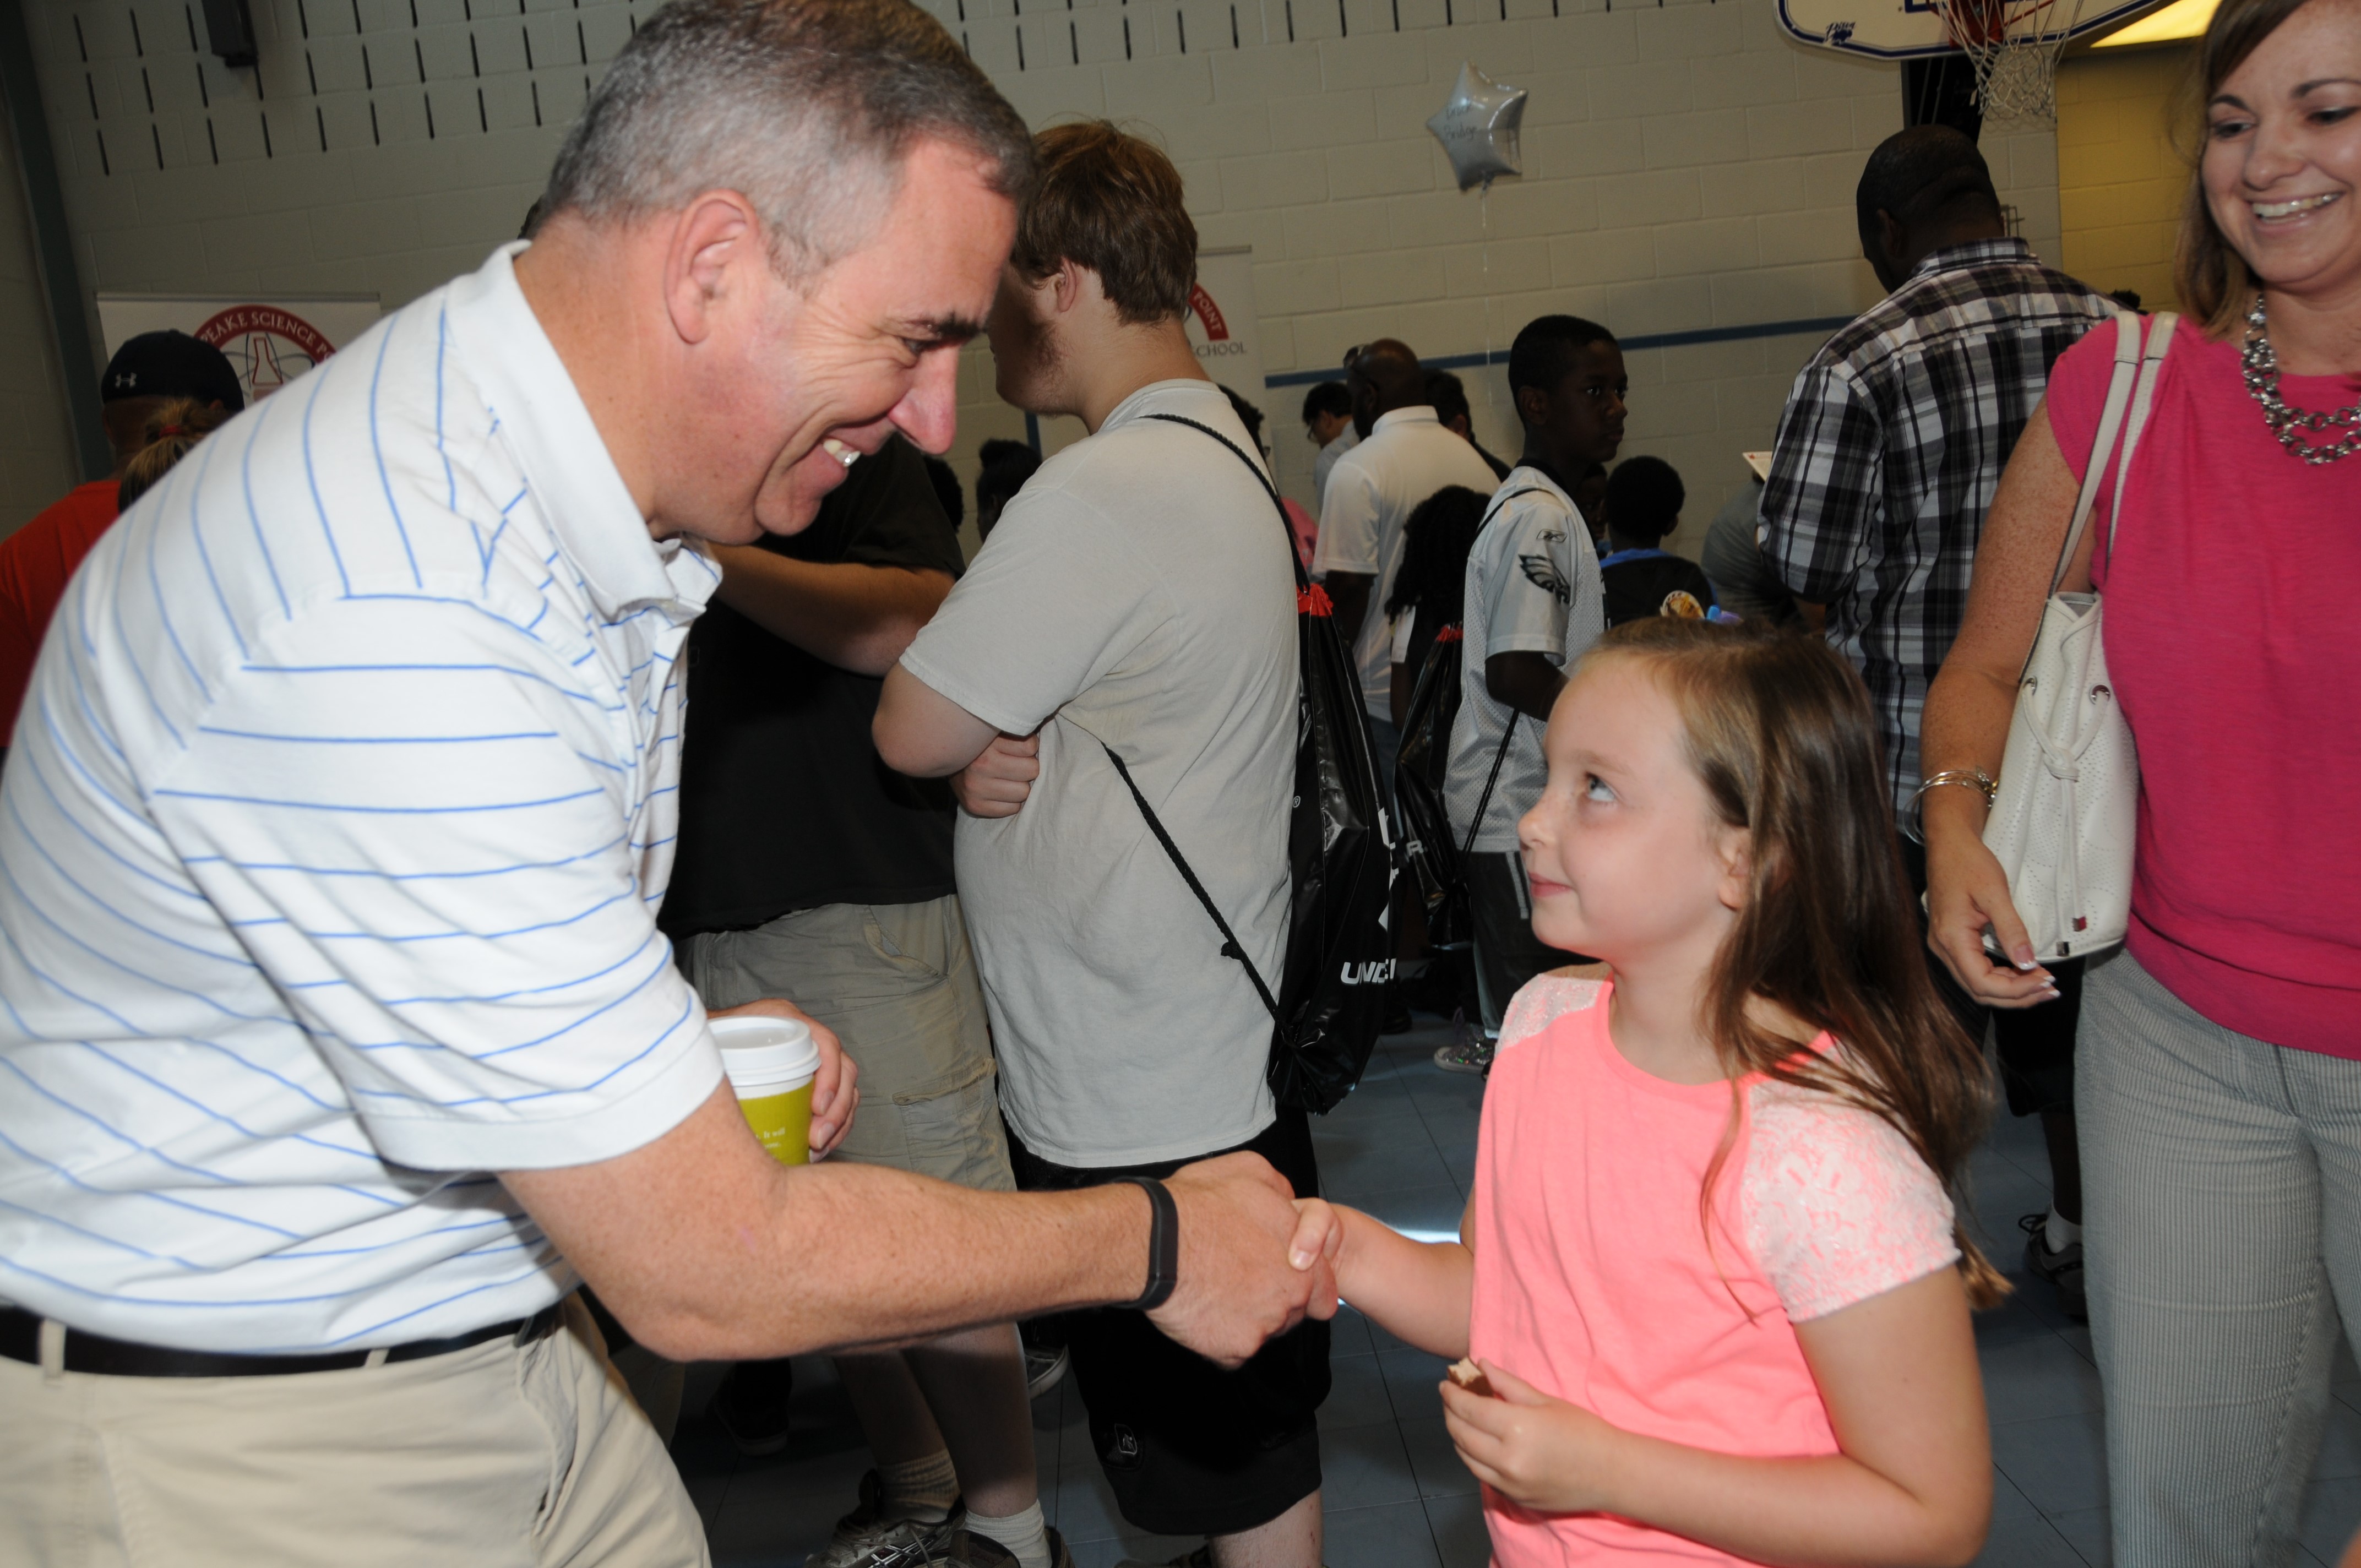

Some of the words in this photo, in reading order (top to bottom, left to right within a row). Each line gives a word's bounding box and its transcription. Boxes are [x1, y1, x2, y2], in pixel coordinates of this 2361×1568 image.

[251, 311, 317, 346] SCIENCE
[1194, 291, 1222, 331] POINT
[1195, 341, 1247, 357] CHOOL
